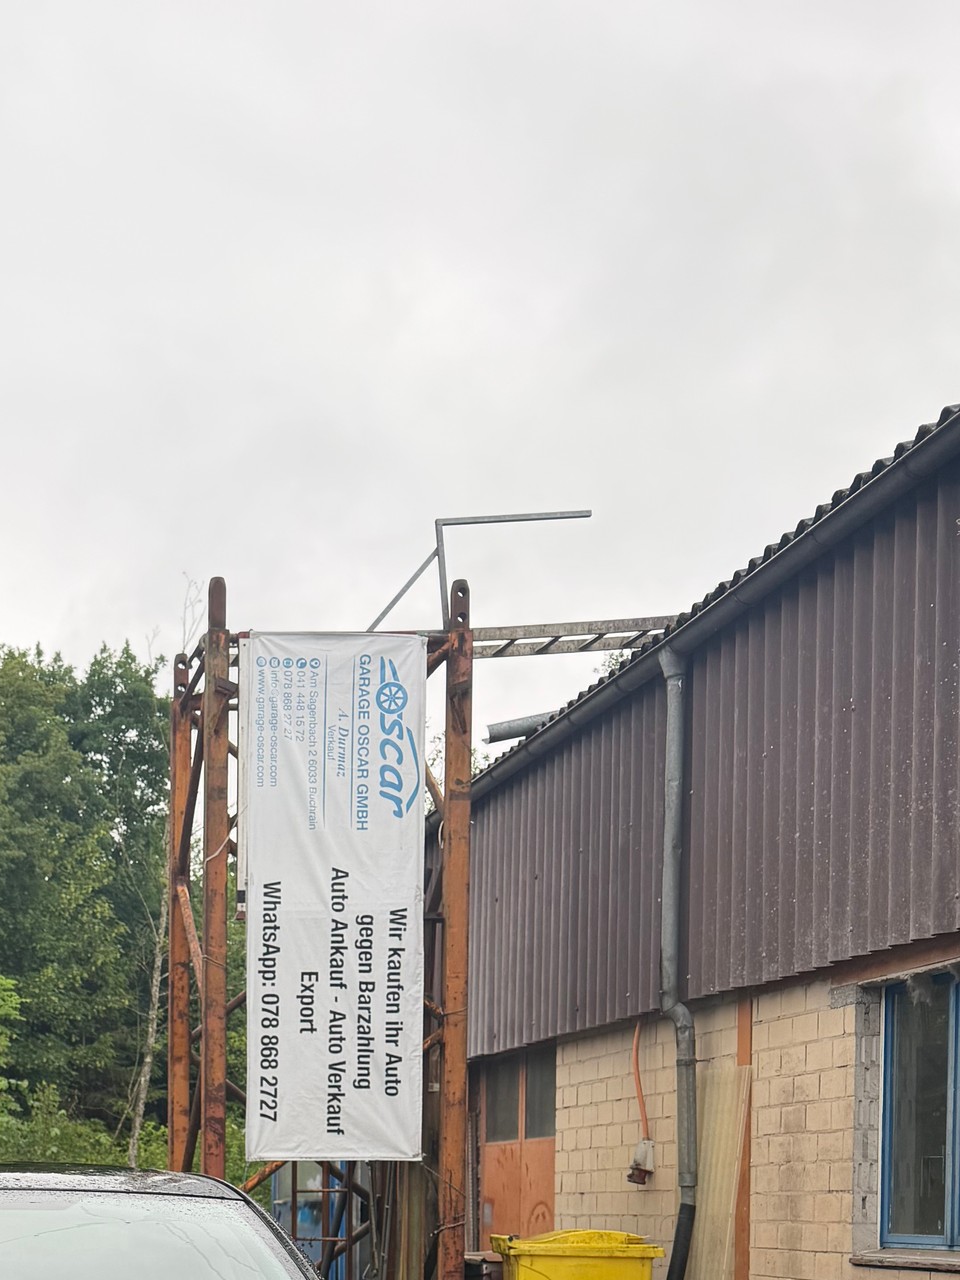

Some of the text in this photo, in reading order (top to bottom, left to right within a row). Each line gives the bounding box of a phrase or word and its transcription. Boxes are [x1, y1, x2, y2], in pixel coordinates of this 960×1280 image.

[283, 670, 293, 689] 078
[283, 692, 292, 711] 868
[295, 671, 306, 742] 041 448 15 72
[310, 671, 319, 688] Am
[256, 669, 266, 788] www.garage-oscar.com
[307, 692, 319, 748] Sagenbach
[327, 725, 336, 761] Verkauf
[336, 708, 349, 777] A. Durmaz
[357, 654, 371, 830] GARAGE OSCAR GMBH
[375, 681, 408, 819] Oscar
[308, 760, 318, 785] 6033
[307, 787, 318, 831] Buchrain
[331, 867, 349, 912] Auto
[330, 919, 348, 989] Ankauf
[258, 881, 281, 1122] WhatsApp: 078 868 2727
[296, 972, 318, 1034] Export
[329, 1010, 346, 1054] Auto
[353, 915, 375, 1089] gegen Barzahlung
[385, 908, 407, 1096] Wir kaufen ihr Auto
[327, 1061, 346, 1135] Verkauf
